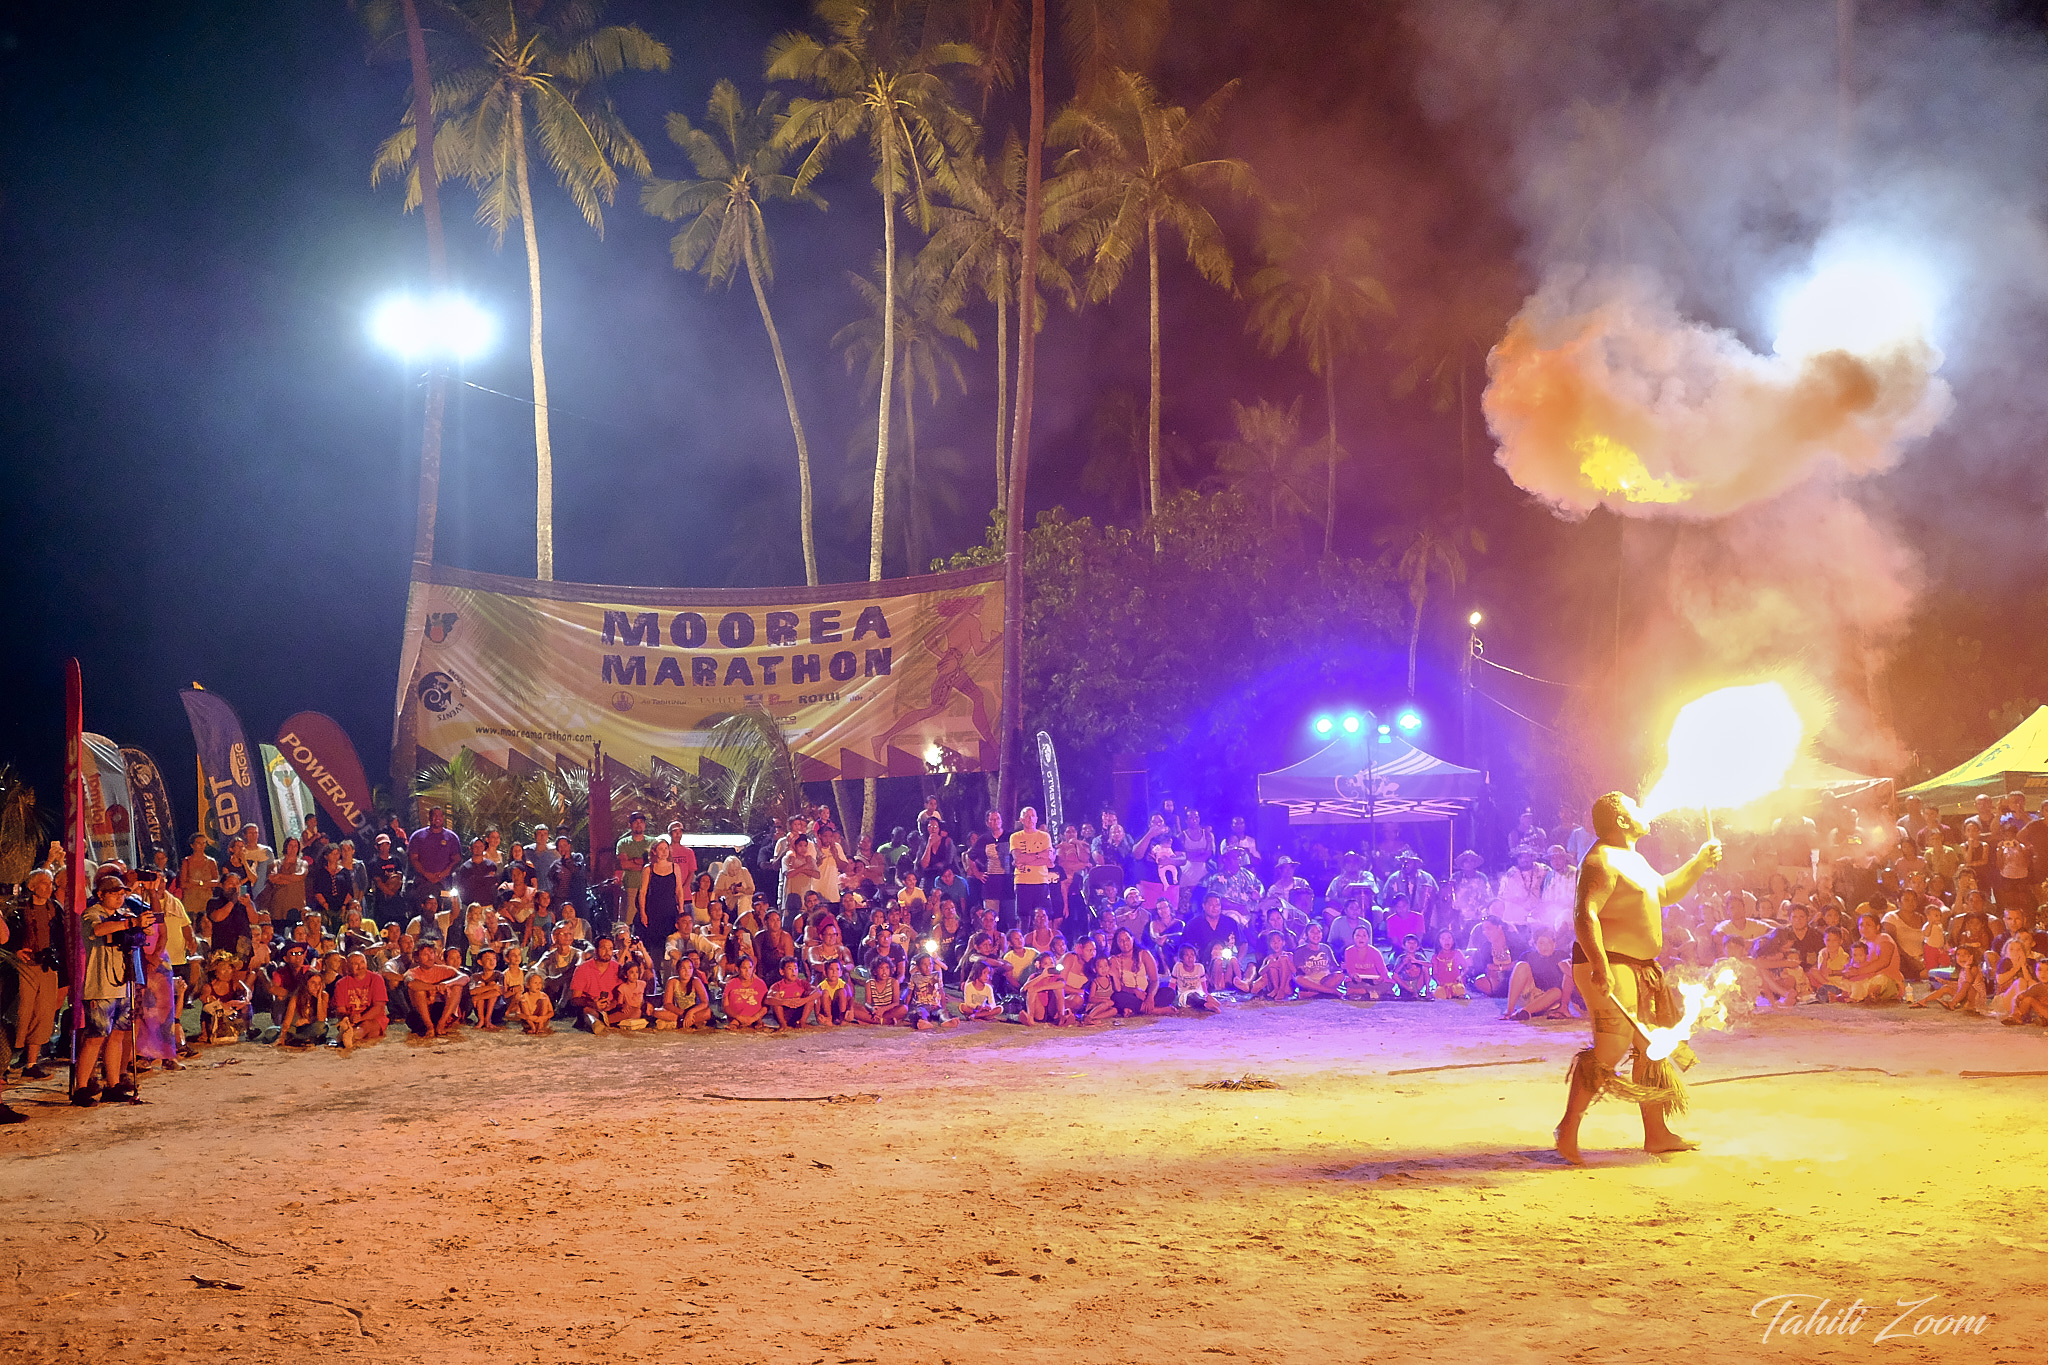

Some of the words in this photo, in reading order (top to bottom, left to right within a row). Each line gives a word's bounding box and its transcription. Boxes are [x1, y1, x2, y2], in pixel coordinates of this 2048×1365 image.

[601, 606, 891, 648] MOOREA
[602, 647, 892, 686] MARATHON
[799, 692, 839, 704] ROTUI
[437, 703, 464, 721] EVENTS
[475, 726, 592, 742] www.mooreamarathon.com
[280, 732, 375, 843] POWERADE
[673, 856, 687, 864] ANS
